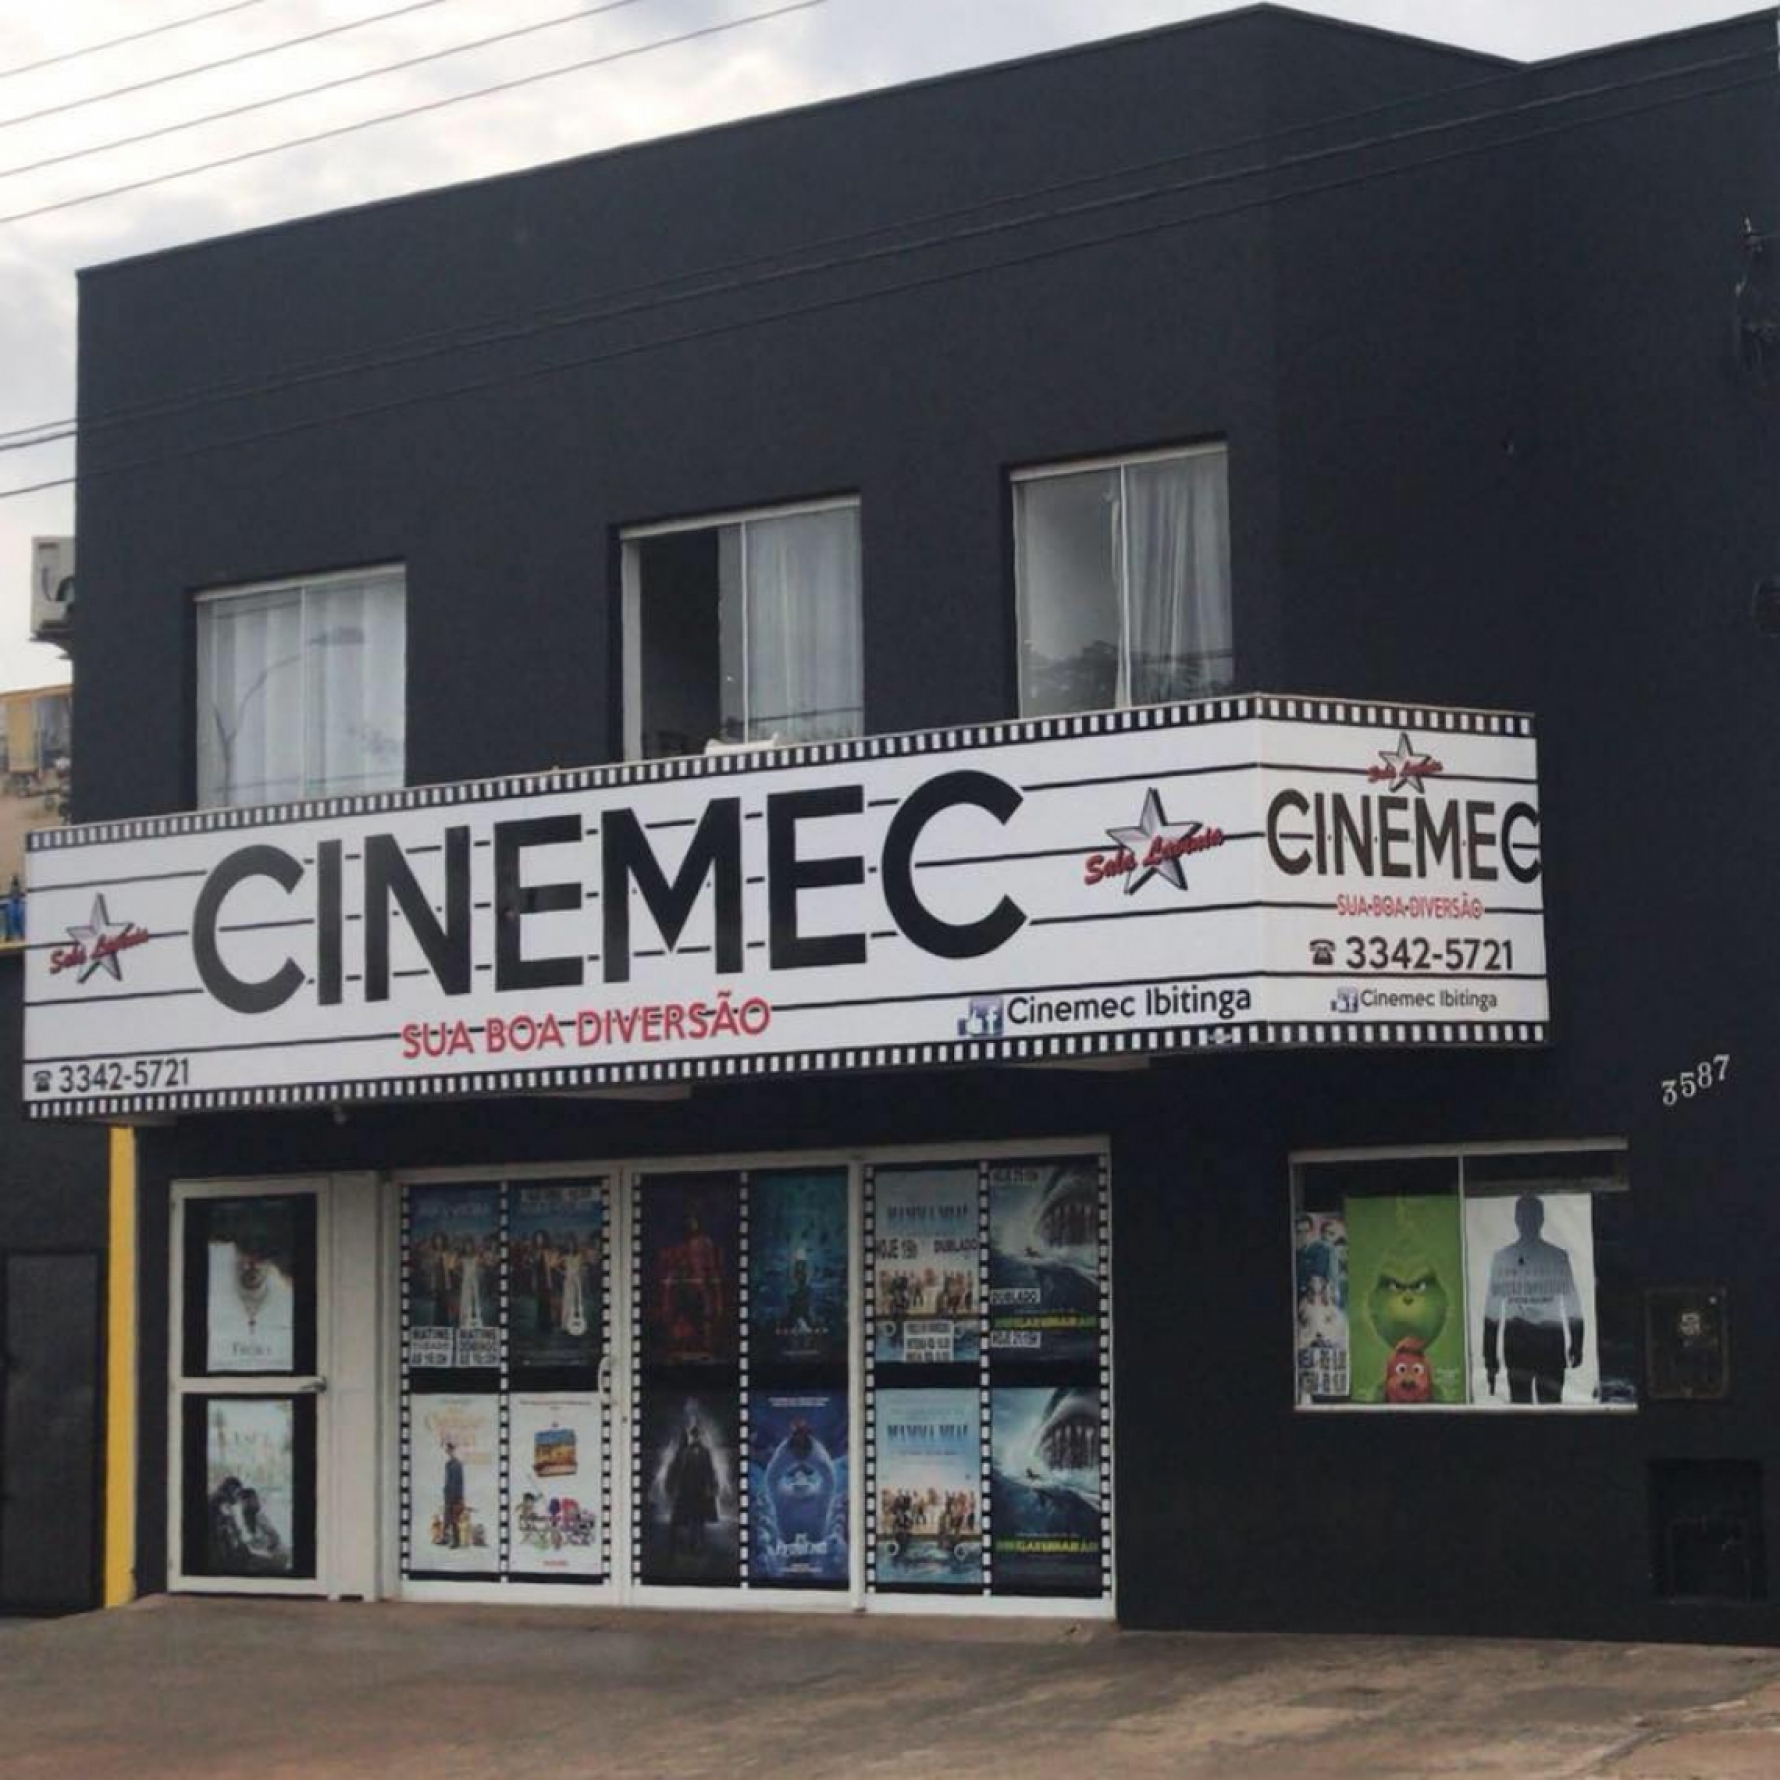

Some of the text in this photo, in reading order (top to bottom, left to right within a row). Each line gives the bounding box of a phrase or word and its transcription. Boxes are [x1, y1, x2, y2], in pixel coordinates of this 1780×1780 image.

[1267, 788, 1542, 884] CINEMEC
[192, 769, 1028, 1014] CINEMEC
[1336, 891, 1486, 920] SUA BOA DIVERSÃO
[1345, 935, 1514, 971] 3342-5721
[1007, 994, 1137, 1025] Cinemec
[1146, 984, 1252, 1020] Ibitinga
[1360, 989, 1498, 1013] Cinemec Ibitinga
[400, 989, 772, 1060] SUA BOA DIVERSÃO
[58, 1058, 189, 1094] 3342-5721
[1660, 1052, 1731, 1108] 3587
